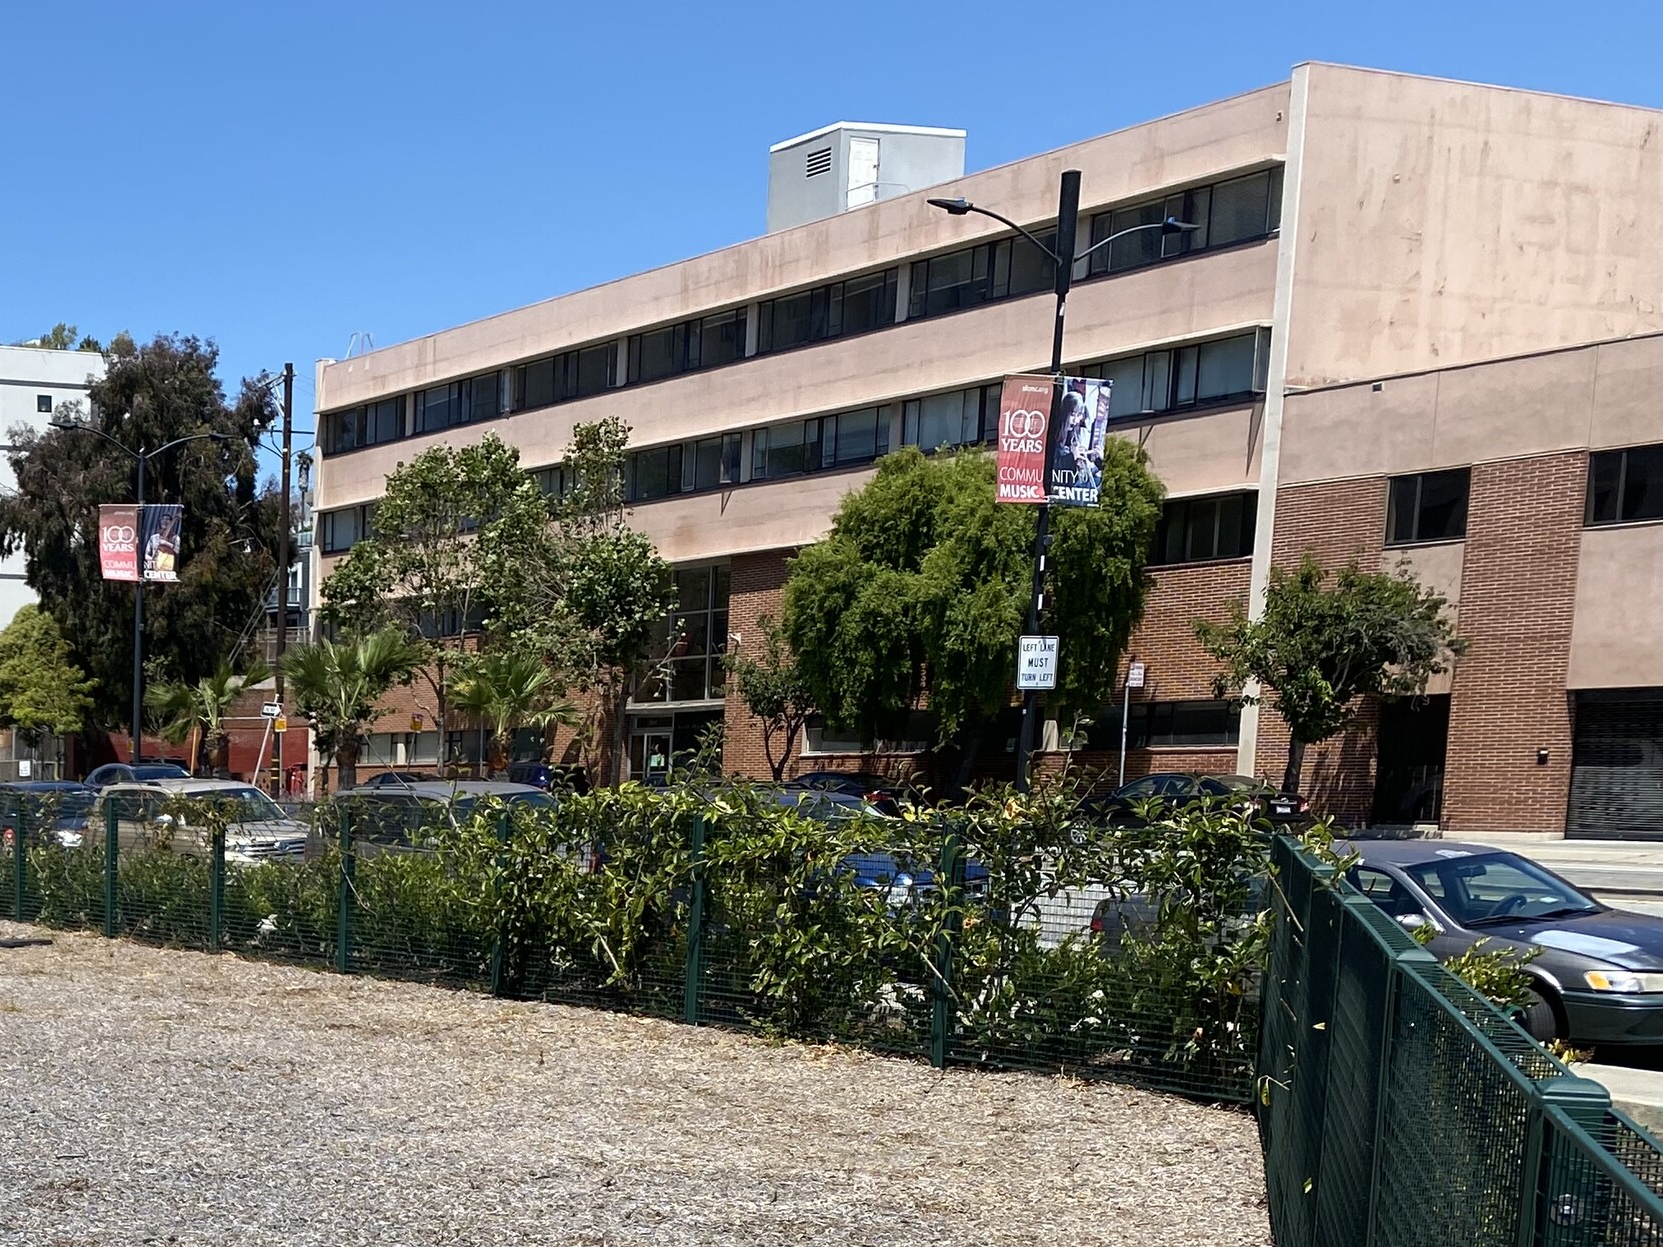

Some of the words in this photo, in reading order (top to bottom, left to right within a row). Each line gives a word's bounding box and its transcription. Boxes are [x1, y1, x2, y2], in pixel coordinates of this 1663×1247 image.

[1002, 409, 1046, 438] 100
[1001, 438, 1043, 453] YEARS
[999, 484, 1040, 498] MUSIC
[102, 525, 135, 543] 100
[102, 544, 135, 552] YEARS
[143, 570, 177, 580] CENTER
[1023, 644, 1037, 652] LEFT
[1040, 644, 1055, 652] LANE
[1028, 658, 1049, 668] MUST
[1021, 673, 1036, 681] TURN
[1039, 673, 1053, 681] LEFT
